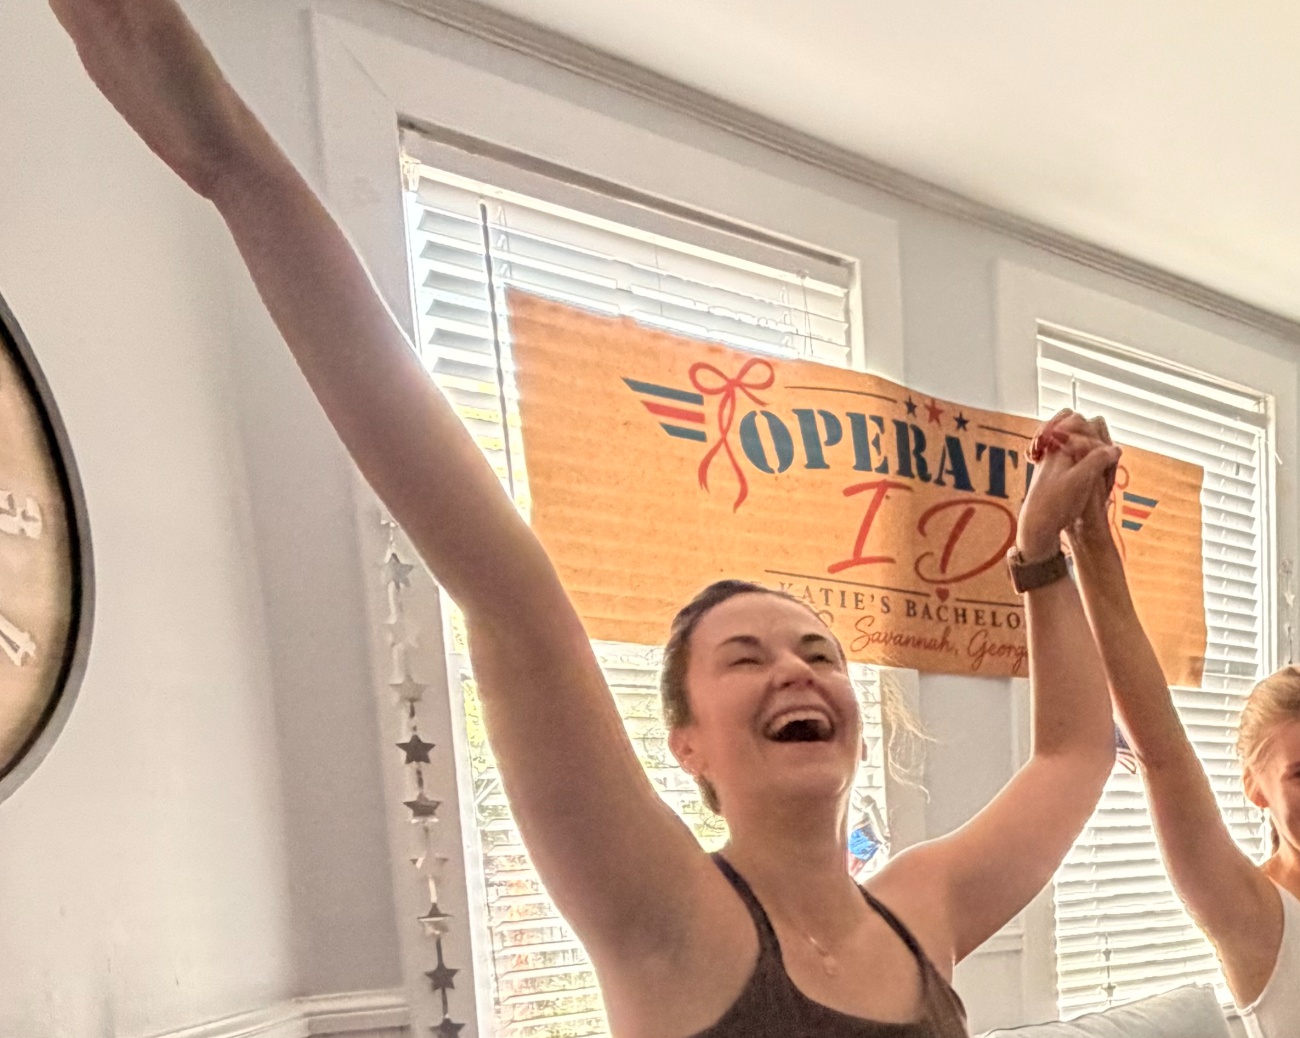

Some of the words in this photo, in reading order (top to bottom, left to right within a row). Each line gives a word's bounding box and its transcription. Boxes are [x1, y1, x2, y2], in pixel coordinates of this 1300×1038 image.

[827, 479, 914, 573] I
[914, 498, 1018, 585] D
[904, 599, 1021, 629] BACHELO
[850, 615, 959, 655] Savannah,
[966, 629, 1028, 674] Georg
